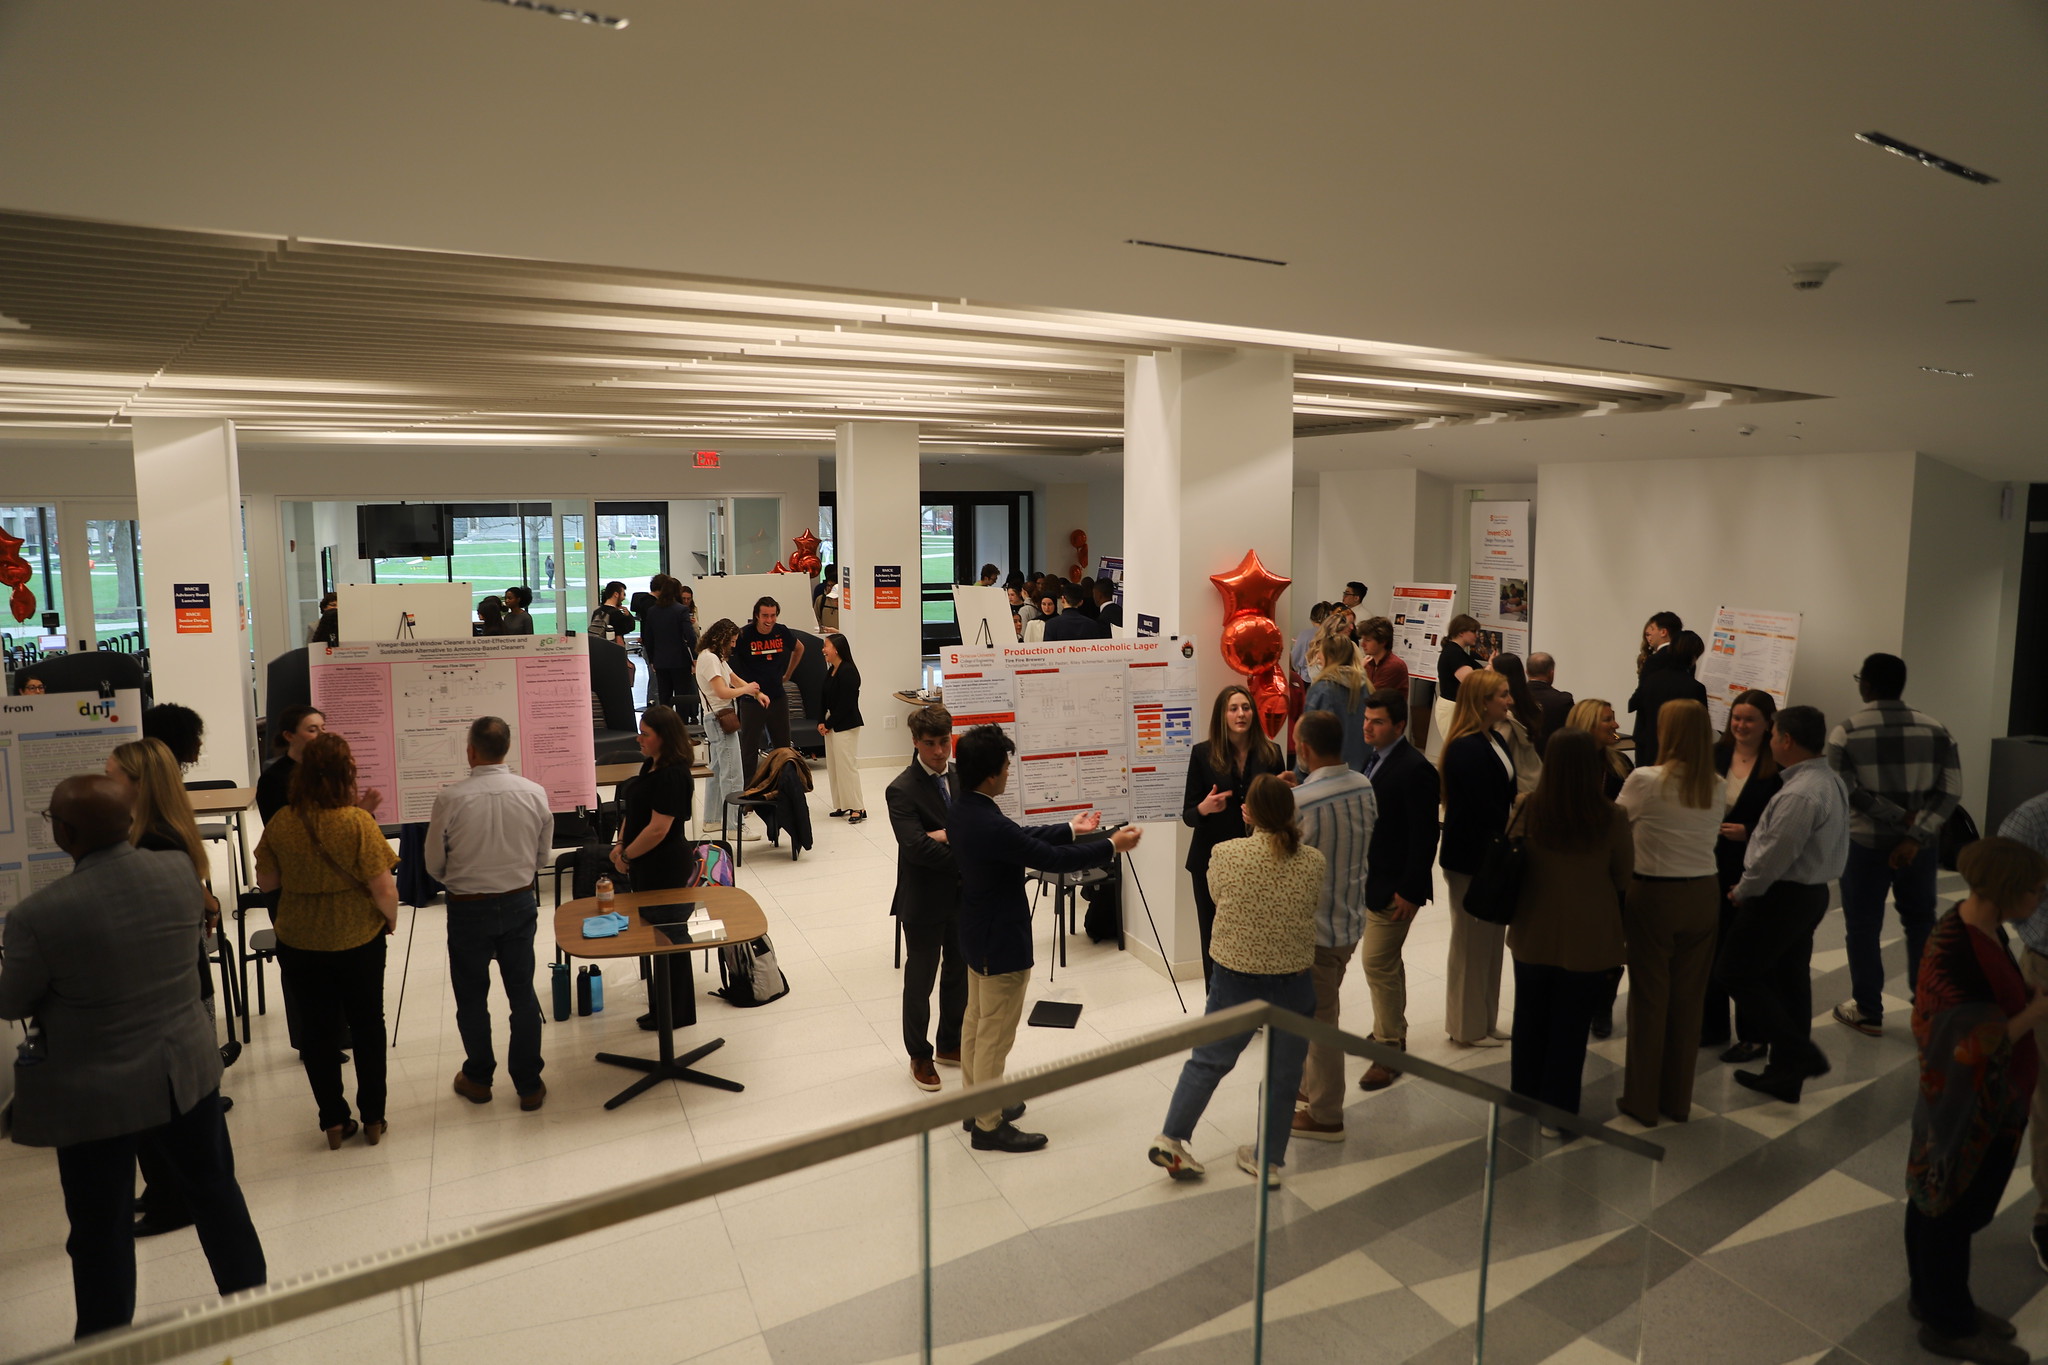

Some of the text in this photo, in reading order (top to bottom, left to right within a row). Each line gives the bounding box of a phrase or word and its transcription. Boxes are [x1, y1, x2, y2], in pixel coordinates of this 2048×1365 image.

[376, 640, 419, 649] Vinegar-Based
[420, 639, 443, 647] Window
[444, 638, 465, 646] Cleaner
[477, 637, 519, 645] Cost-Effective
[380, 647, 414, 655] Sustainable
[415, 646, 446, 654] Alternative
[454, 644, 500, 652] Ammonia-Based
[500, 643, 525, 651] Cleaners
[750, 638, 784, 651] ORANGE
[1004, 642, 1159, 656] Production of Non-Alcoholic Lager
[950, 653, 959, 664] S
[3, 701, 110, 718] from dnj
